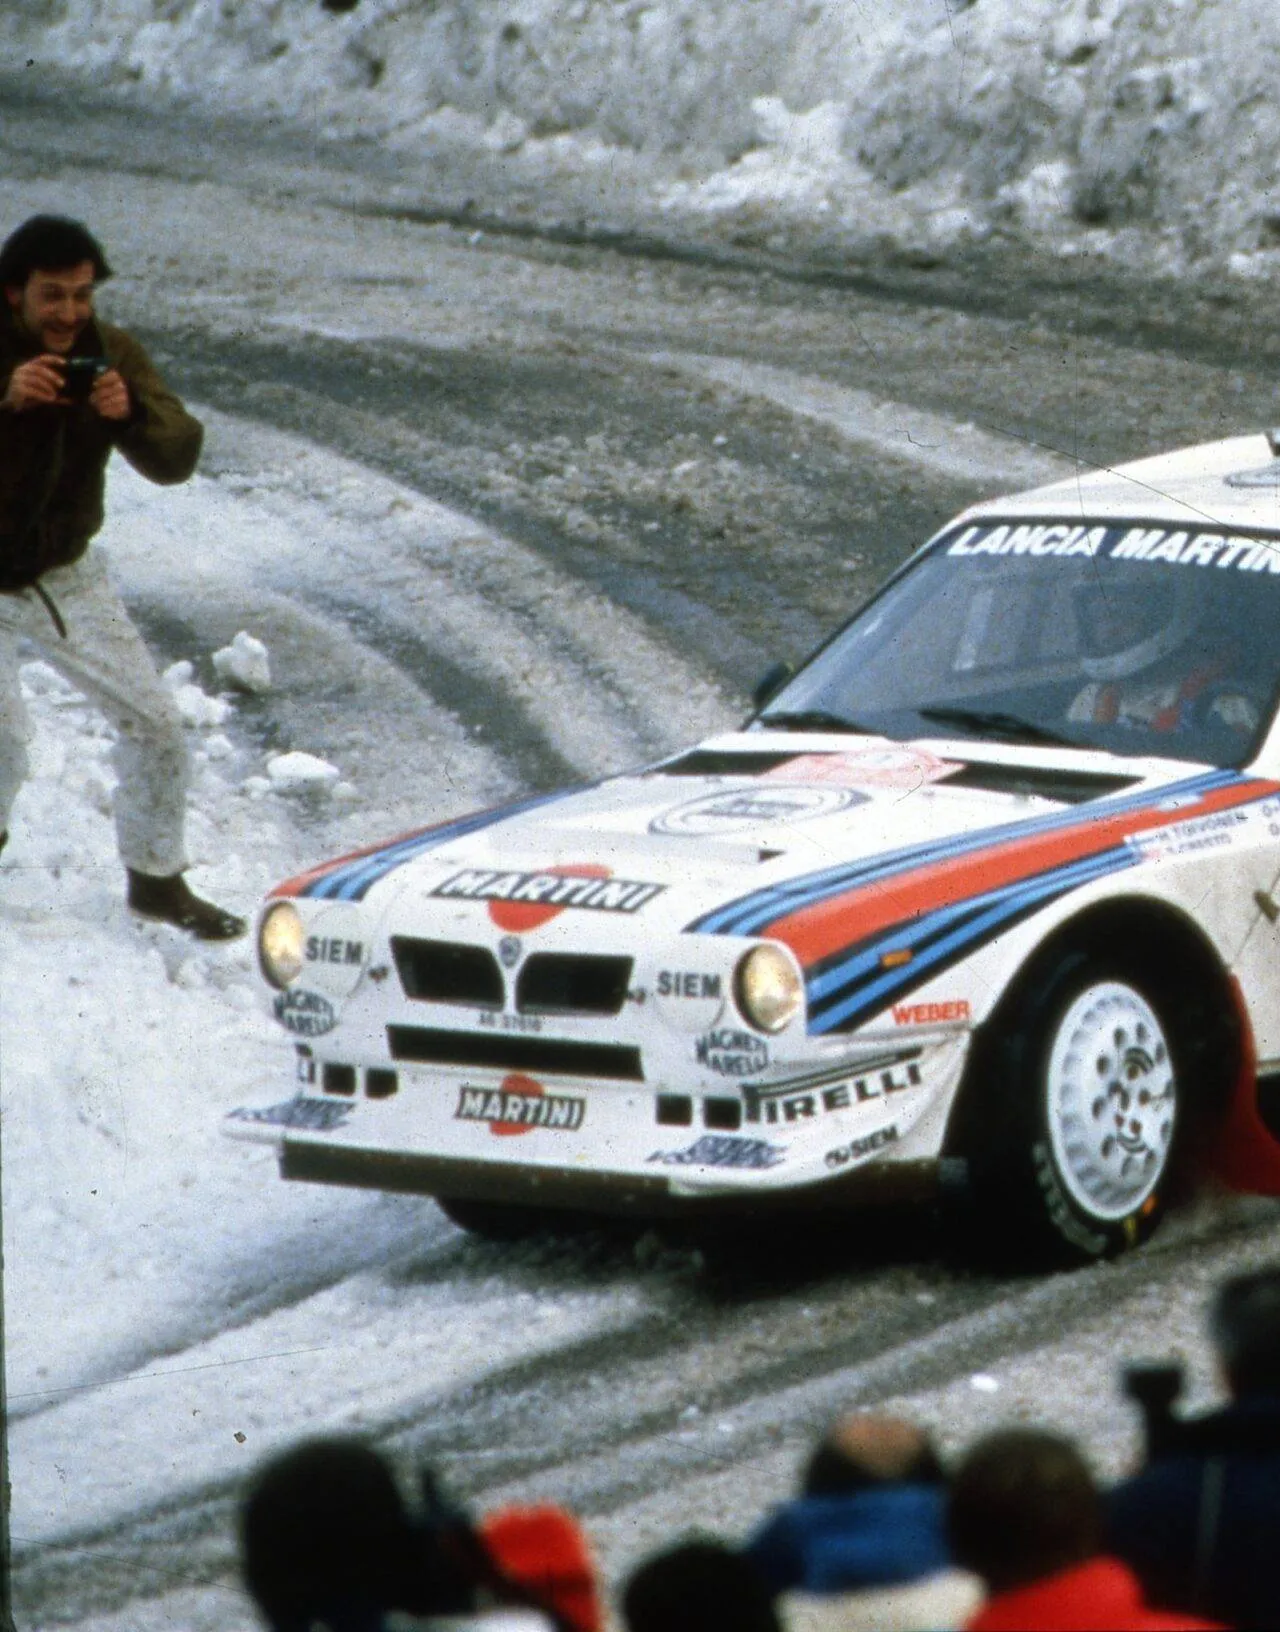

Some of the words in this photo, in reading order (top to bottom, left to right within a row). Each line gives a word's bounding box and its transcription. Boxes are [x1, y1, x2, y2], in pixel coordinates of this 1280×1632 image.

[948, 525, 1107, 556] LANCIA
[441, 869, 663, 911] MARTINI
[306, 935, 362, 965] SIEM
[658, 970, 721, 998] SIEM
[892, 1000, 970, 1026] WEBER
[741, 1047, 922, 1123] PIRELLI
[460, 1090, 581, 1129] MARTINI
[851, 1125, 899, 1157] SIEM
